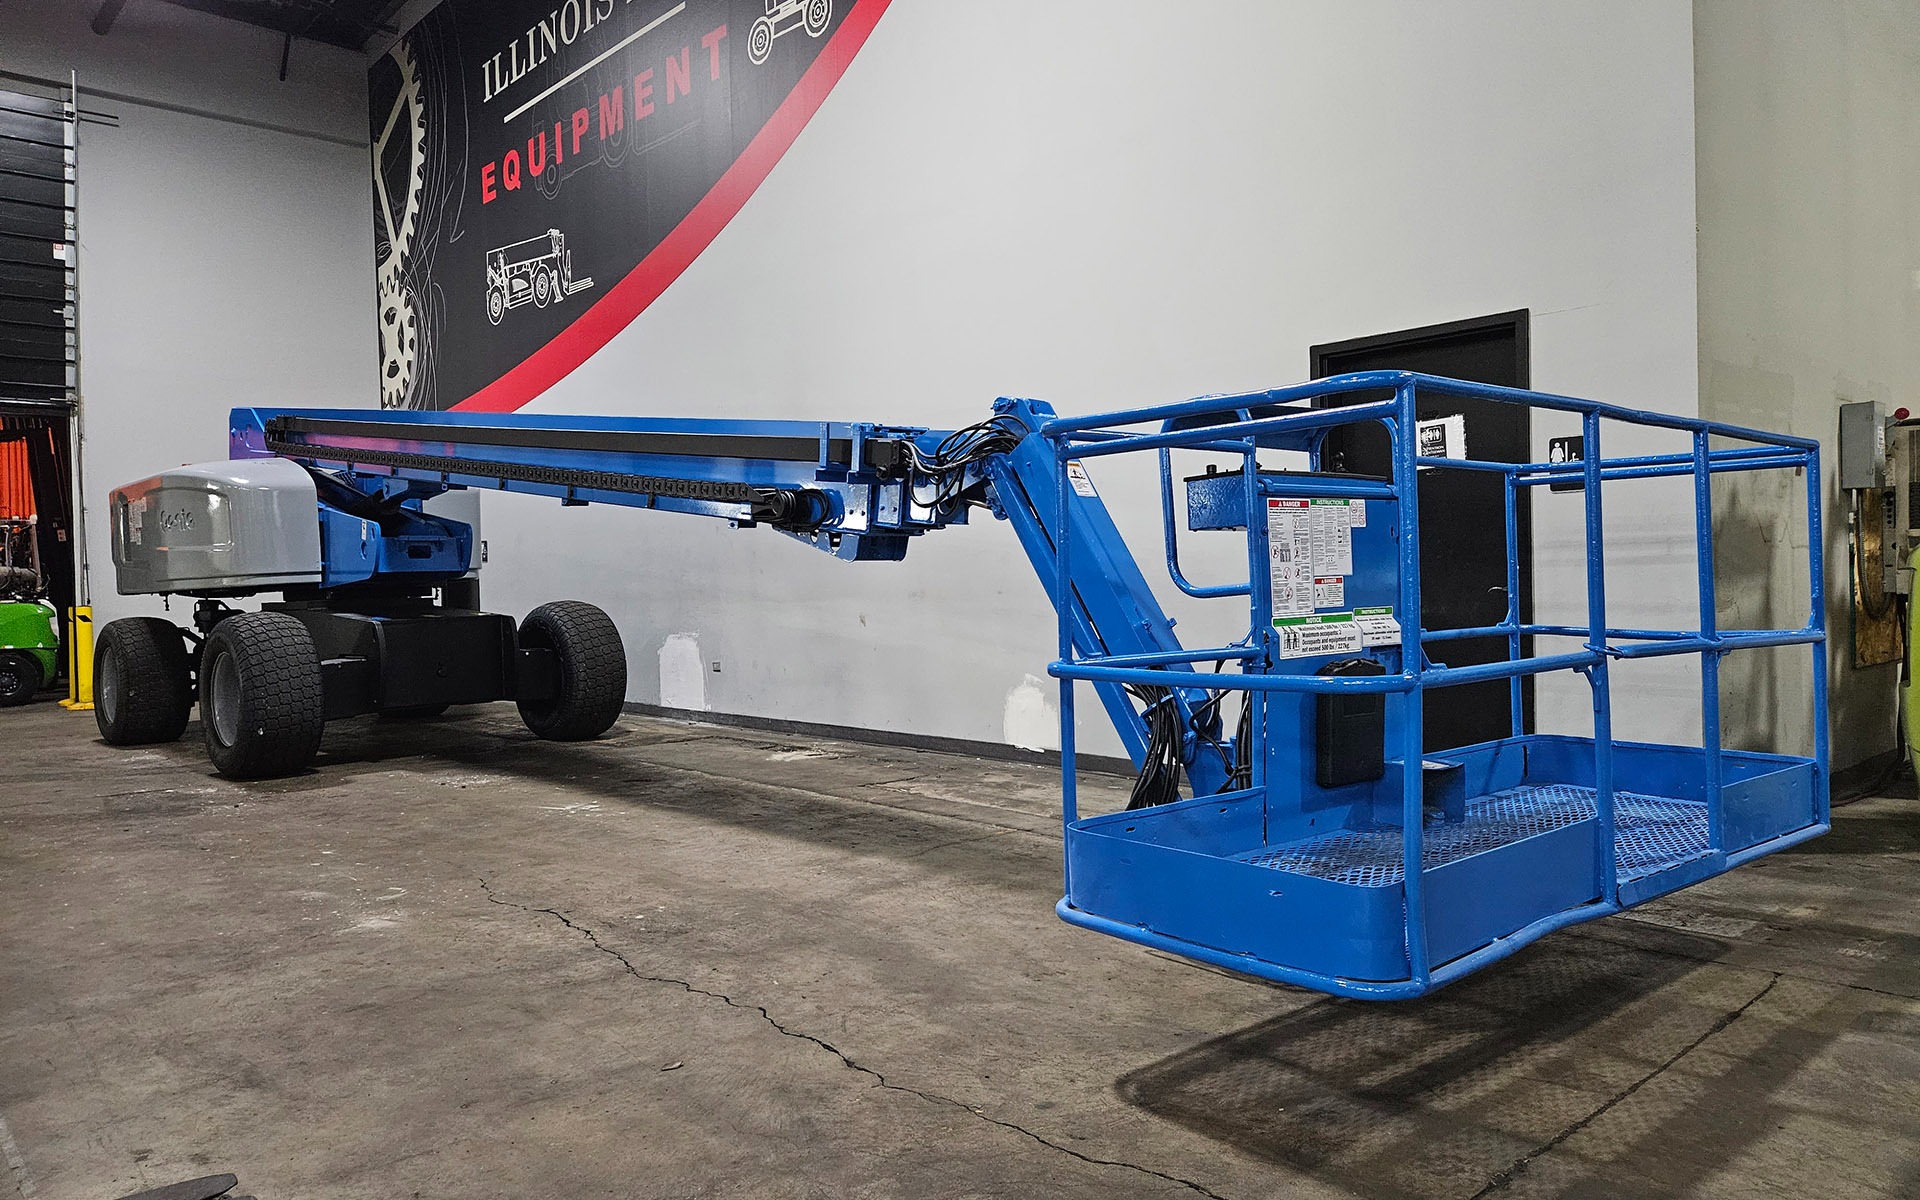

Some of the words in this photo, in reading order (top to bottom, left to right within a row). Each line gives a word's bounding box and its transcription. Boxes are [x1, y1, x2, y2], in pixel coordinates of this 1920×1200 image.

[482, 0, 614, 103] ILLINOIS
[480, 24, 728, 205] EQUIPMENT
[160, 508, 194, 534] Genie
